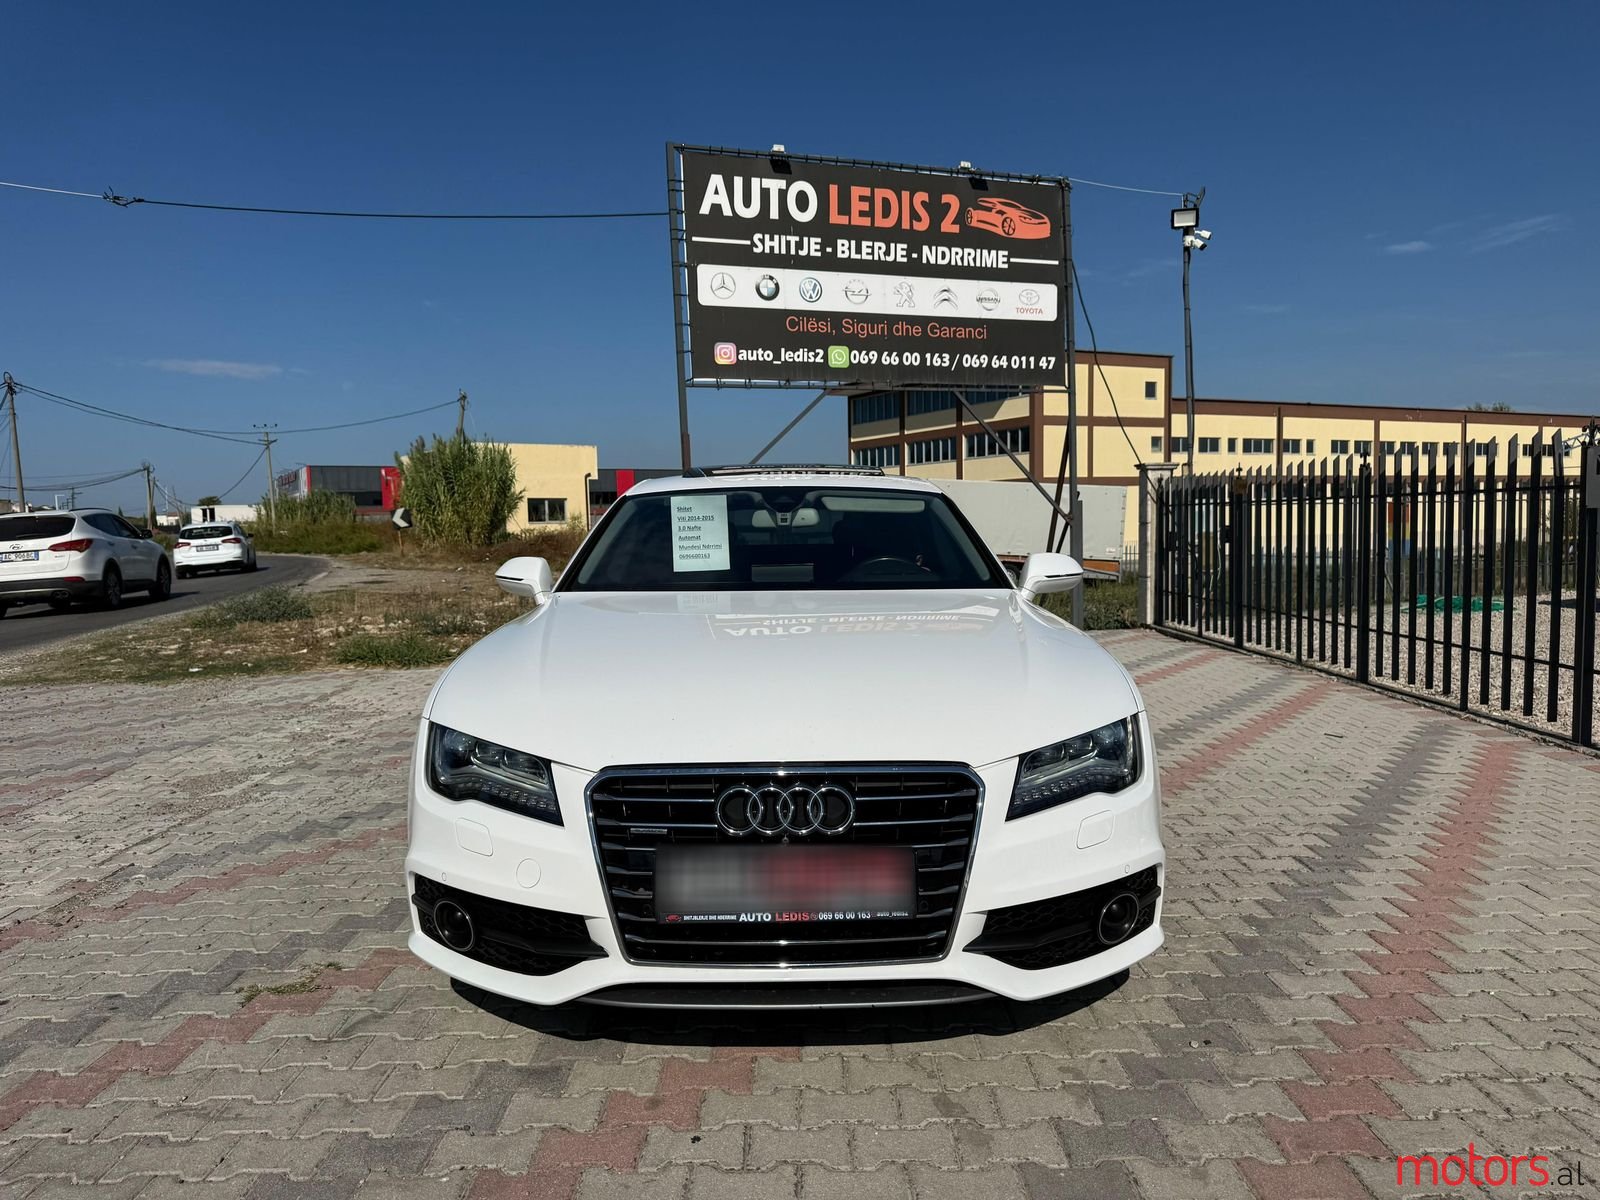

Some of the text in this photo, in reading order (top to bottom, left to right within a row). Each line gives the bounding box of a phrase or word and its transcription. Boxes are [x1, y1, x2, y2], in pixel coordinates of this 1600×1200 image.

[699, 173, 960, 234] AUTO LEDIS 2
[752, 233, 822, 257] SHITJE
[837, 238, 907, 263] BLERJE
[922, 244, 1009, 269] NDRRIME
[1016, 307, 1044, 315] TOYOTA
[785, 315, 987, 340] Cilësi, Siguri dhe Garanci
[738, 347, 824, 365] auto_ledis2
[850, 350, 878, 365] 069
[881, 351, 899, 366] 66
[902, 351, 920, 366] 00
[925, 352, 950, 367] 163
[962, 354, 988, 368] 069
[991, 355, 1008, 369] 64
[1011, 355, 1035, 370] 011
[1039, 356, 1056, 370] 47
[739, 912, 771, 922] AUTO
[775, 911, 809, 921] LEDIS
[818, 911, 832, 920] 069
[834, 911, 844, 919] 66
[846, 911, 856, 919] 00
[857, 910, 871, 919] 163
